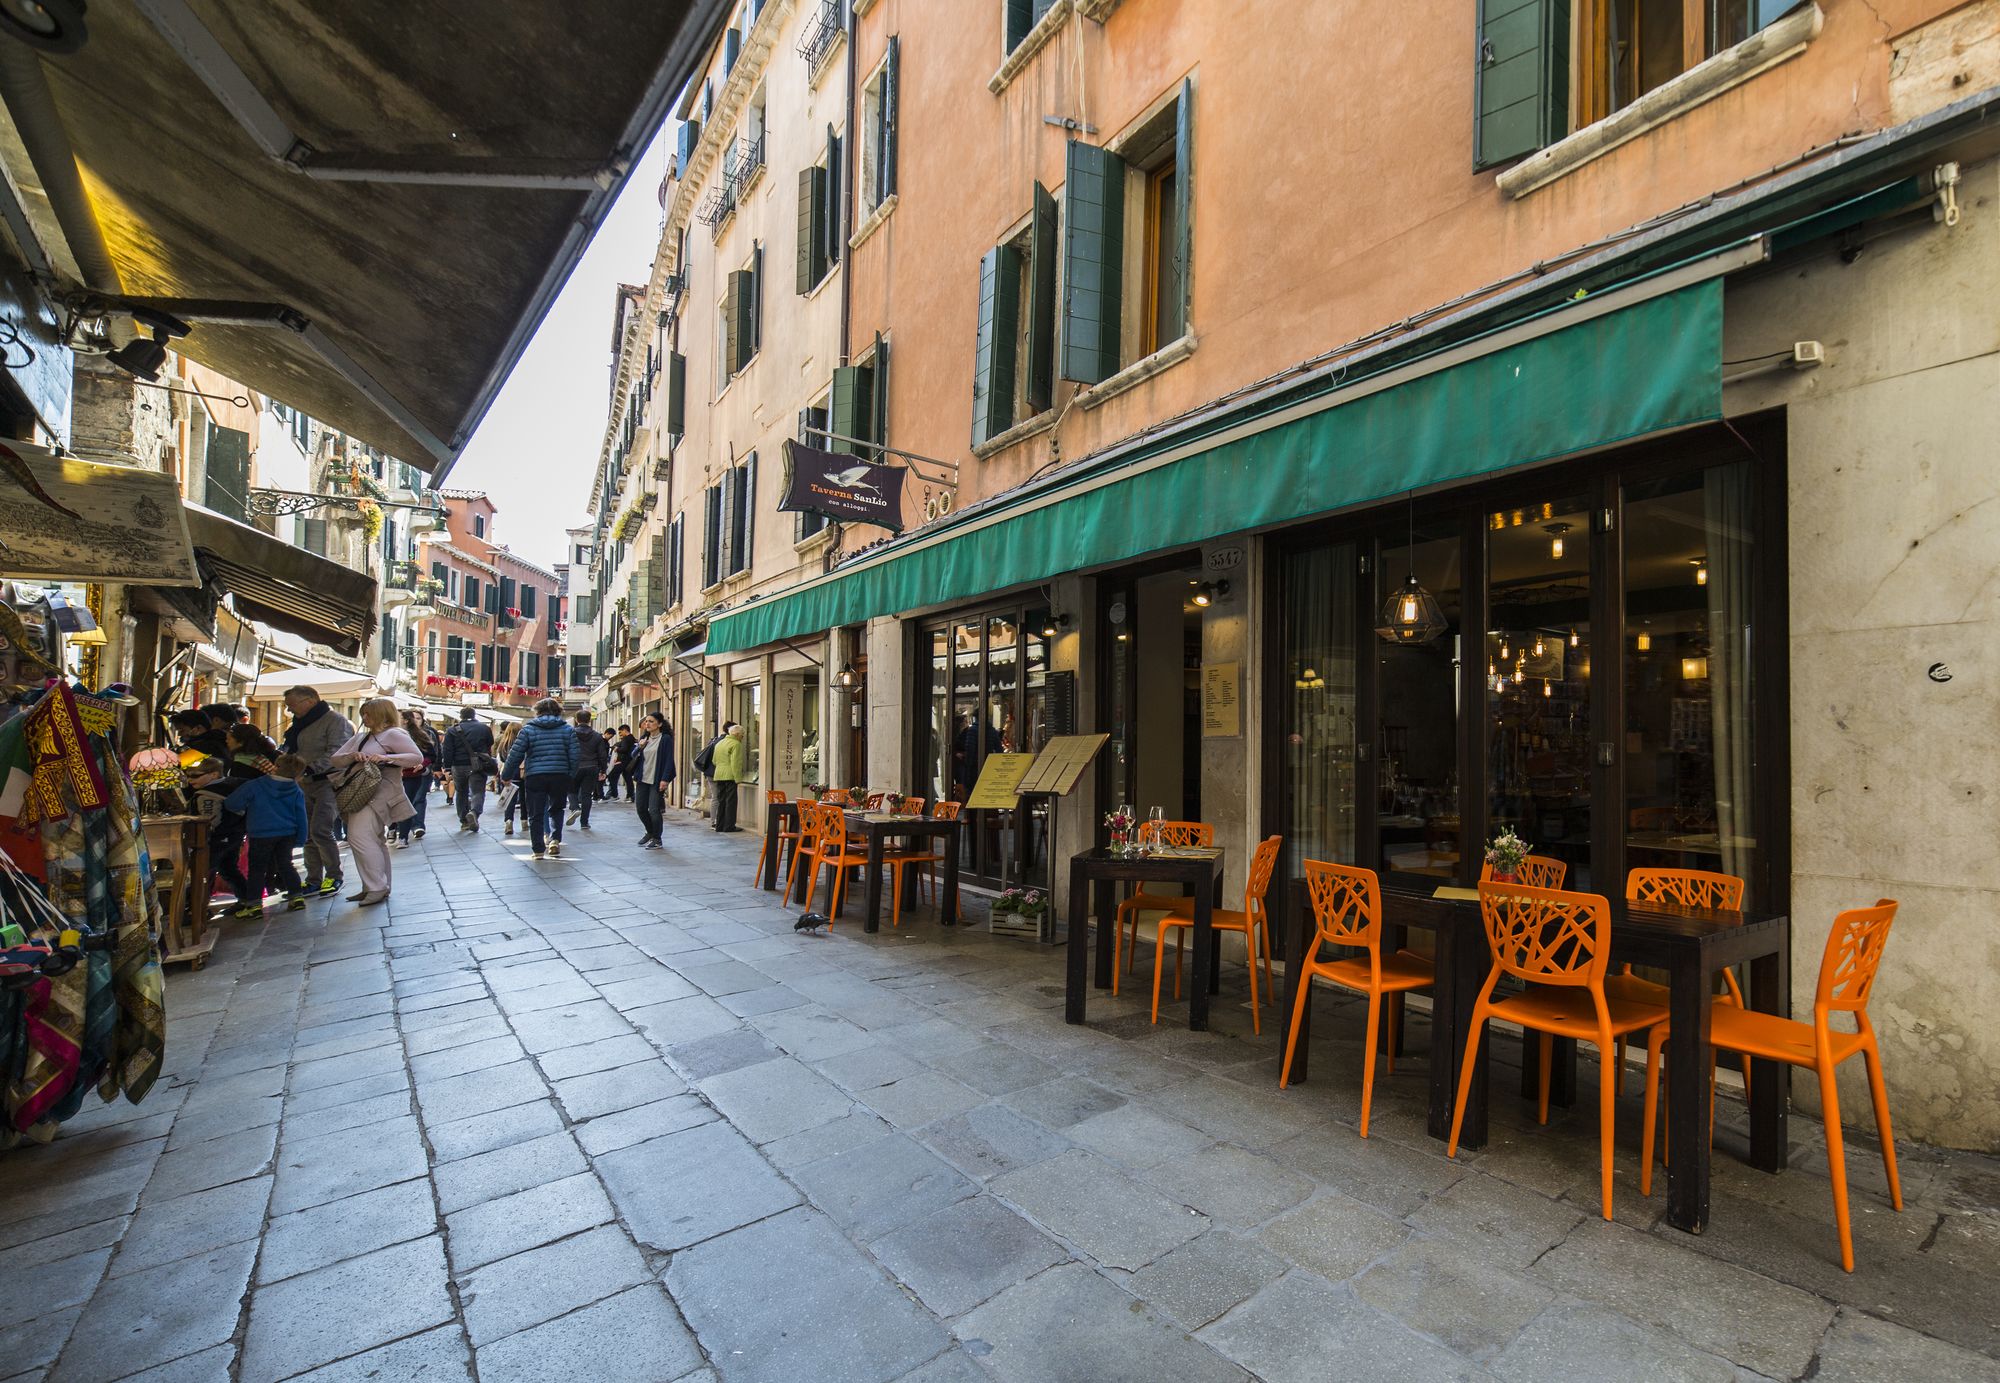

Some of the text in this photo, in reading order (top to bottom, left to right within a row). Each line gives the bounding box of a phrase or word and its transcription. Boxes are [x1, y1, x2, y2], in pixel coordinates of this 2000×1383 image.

[810, 483, 887, 506] Taverna SanLio
[437, 603, 460, 621] HOTEL
[72, 694, 111, 710] OFFERTA
[785, 688, 794, 776] ANTICHI SPLENDORI
